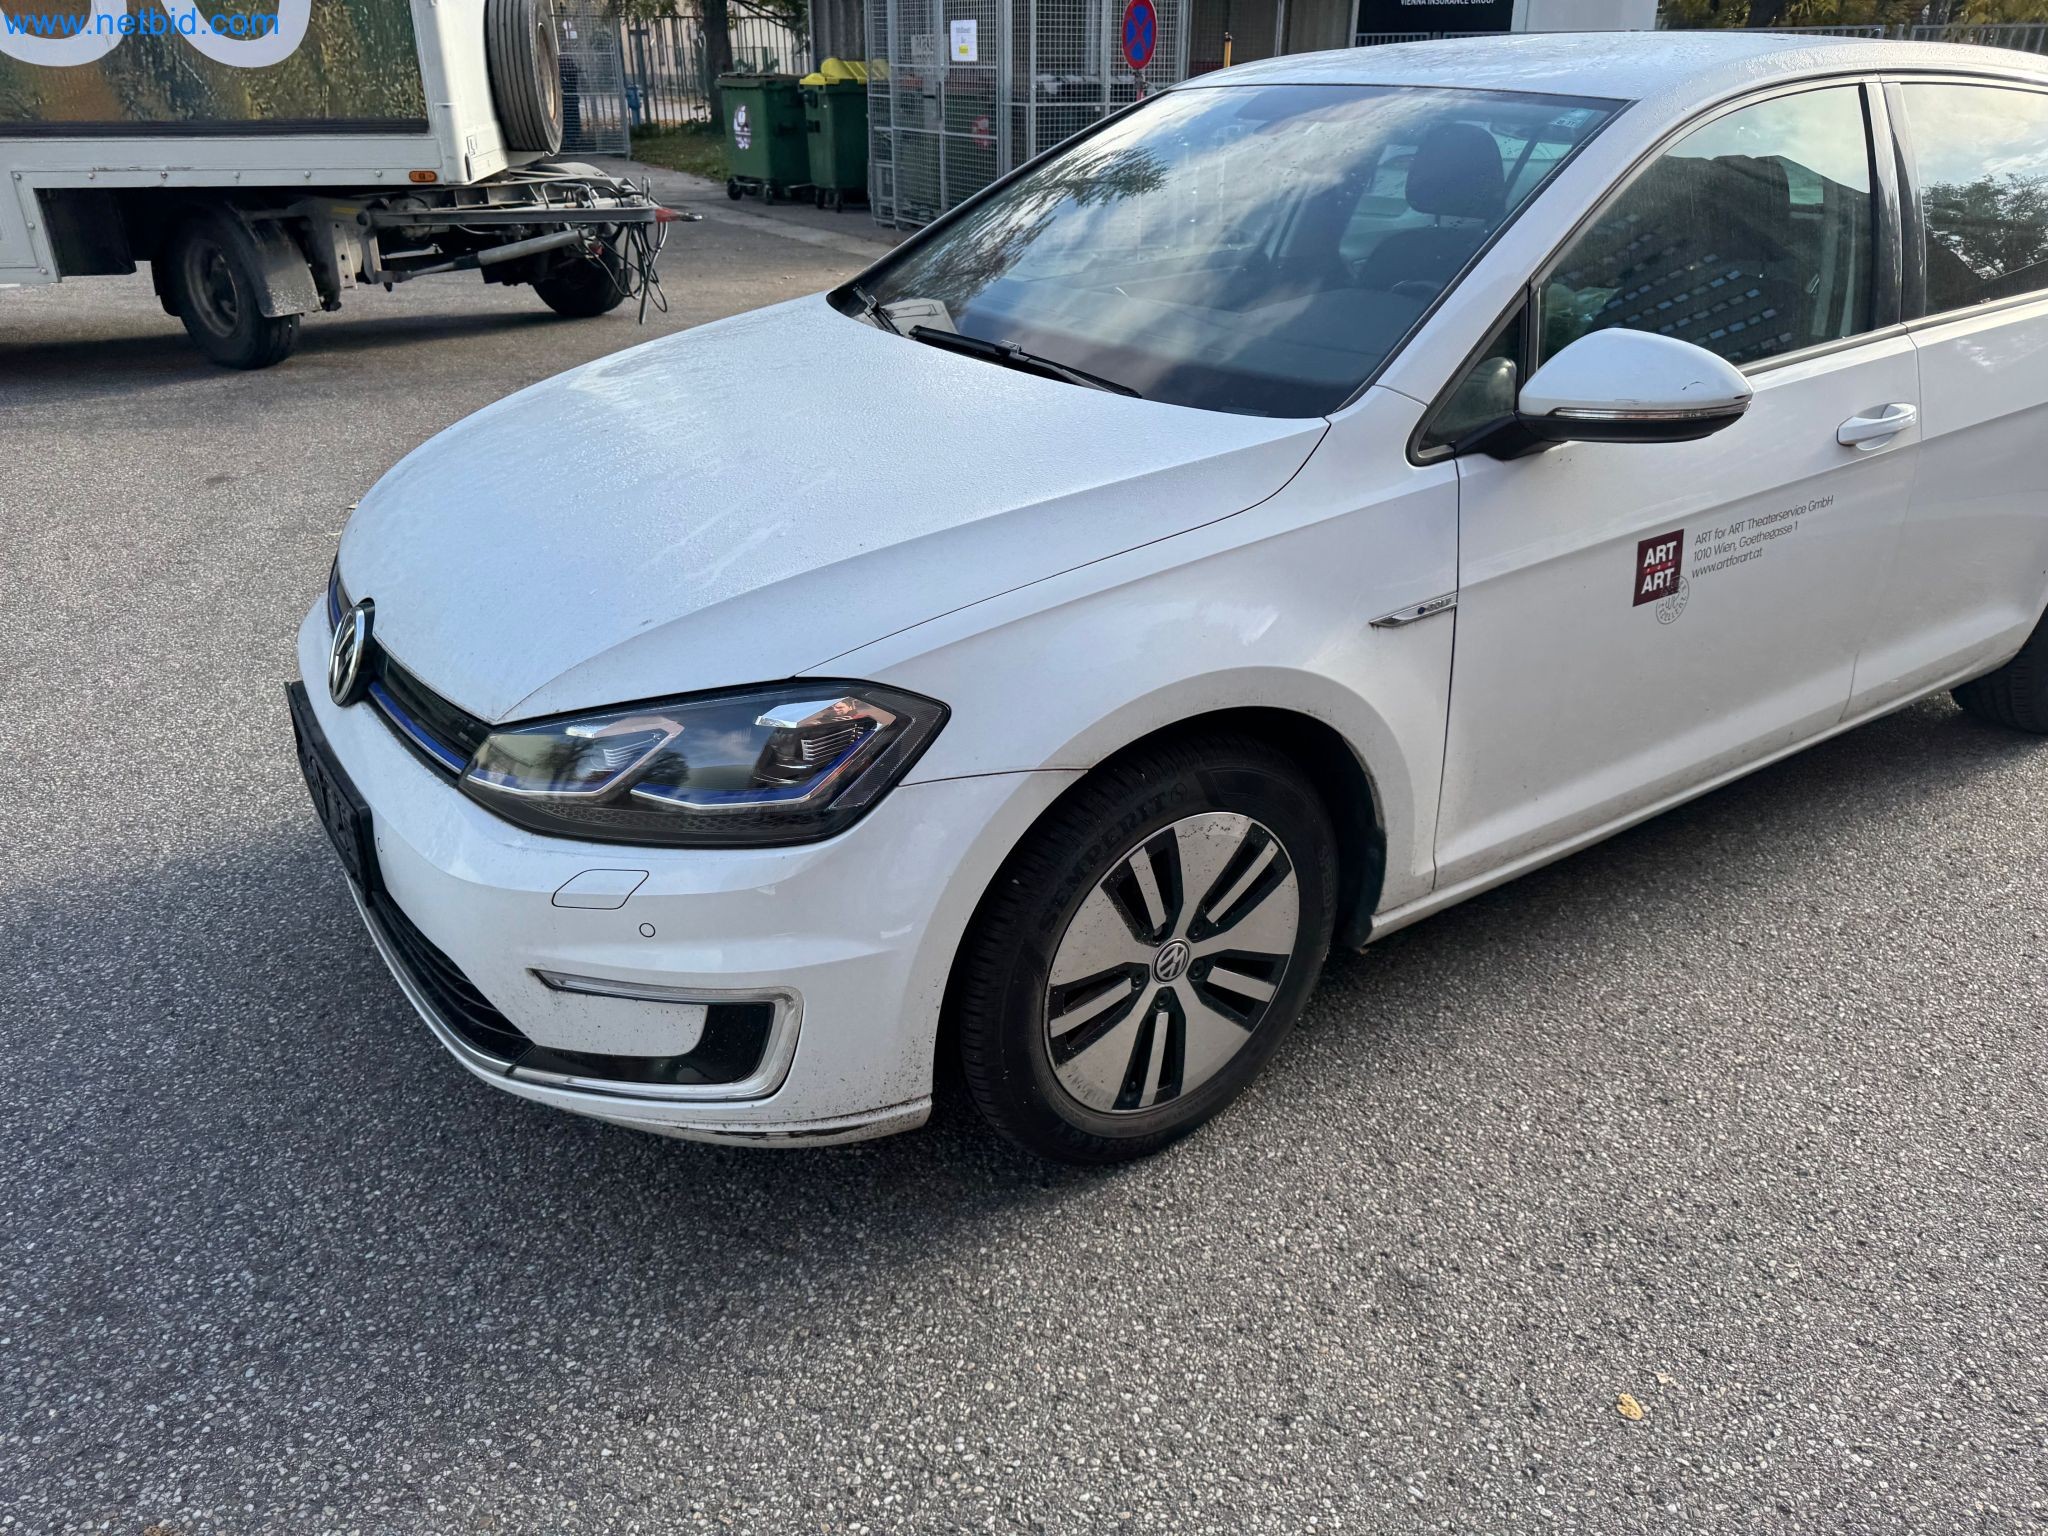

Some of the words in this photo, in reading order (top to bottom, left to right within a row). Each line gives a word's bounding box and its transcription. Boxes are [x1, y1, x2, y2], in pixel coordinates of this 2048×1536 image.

[1694, 530, 1713, 547] ART
[1714, 527, 1727, 540] for
[1727, 520, 1746, 536] ART
[1747, 504, 1807, 531] Theaterservice
[1807, 494, 1834, 513] GmbH
[1643, 540, 1678, 568] ART
[1694, 546, 1713, 562] 1010
[1713, 541, 1738, 556] Wien,
[1739, 524, 1793, 549] Goethegasse
[1691, 547, 1764, 579] www.artforart.at
[1640, 567, 1676, 595] ART
